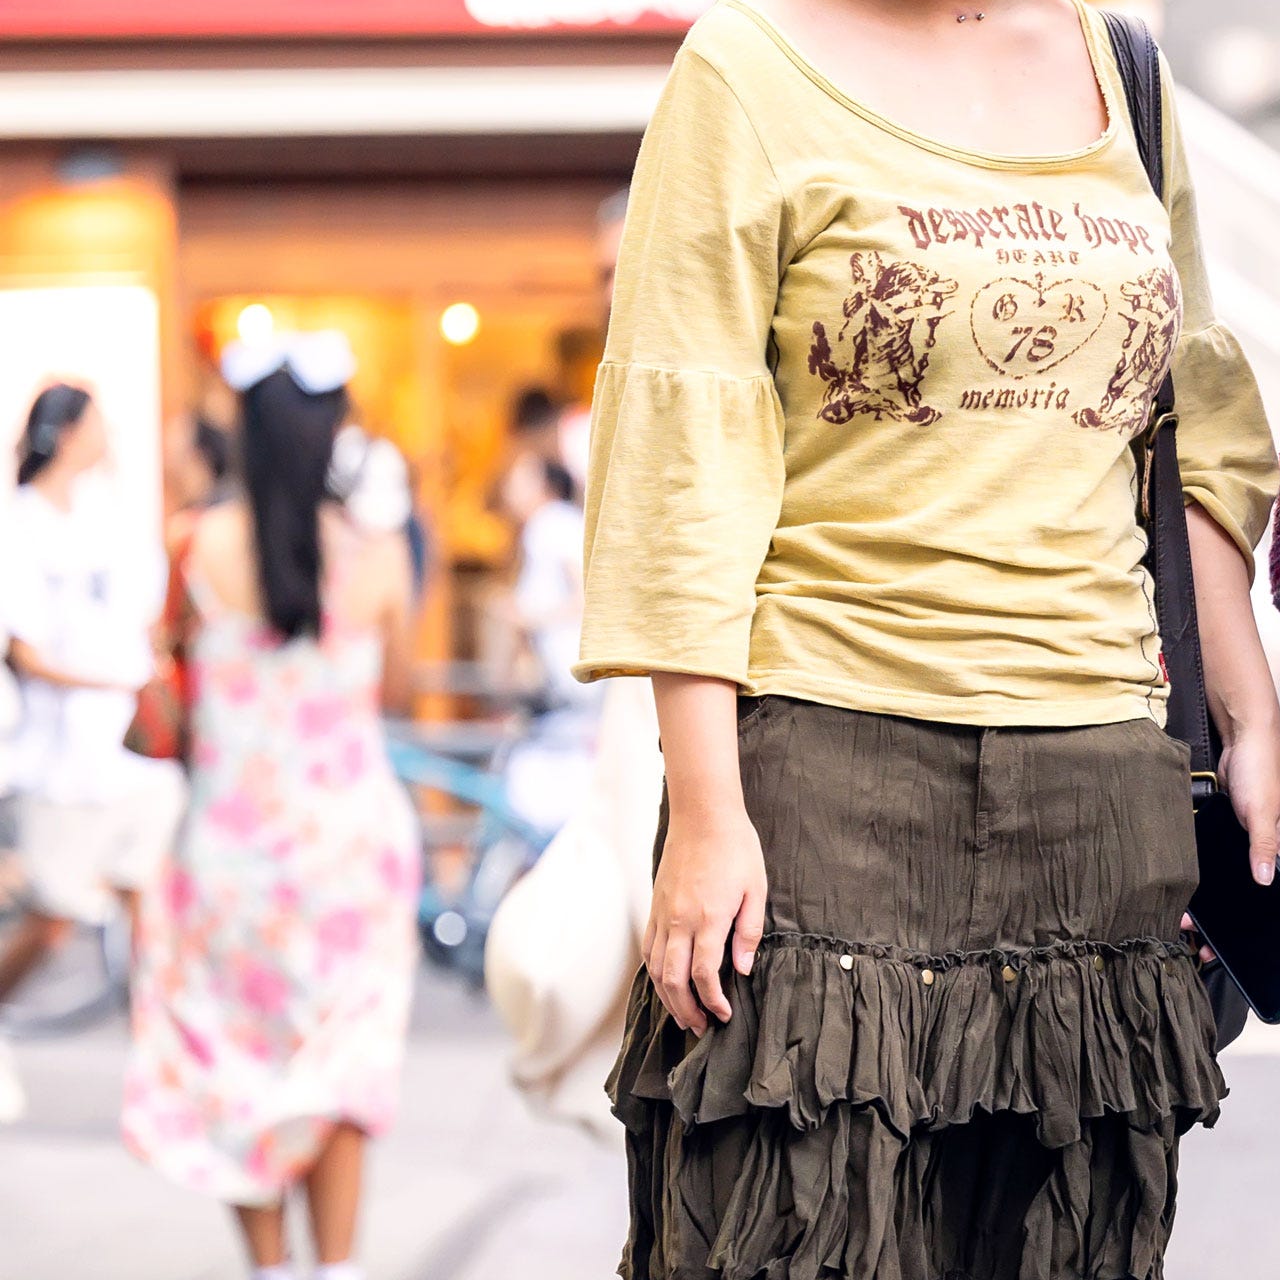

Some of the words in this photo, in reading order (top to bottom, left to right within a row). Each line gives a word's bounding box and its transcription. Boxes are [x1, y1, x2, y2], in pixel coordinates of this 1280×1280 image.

[897, 200, 1067, 250] desperate
[1072, 202, 1154, 255] hope
[995, 248, 1080, 266] HEART
[1003, 325, 1058, 363] 78
[959, 381, 1070, 410] memoria
